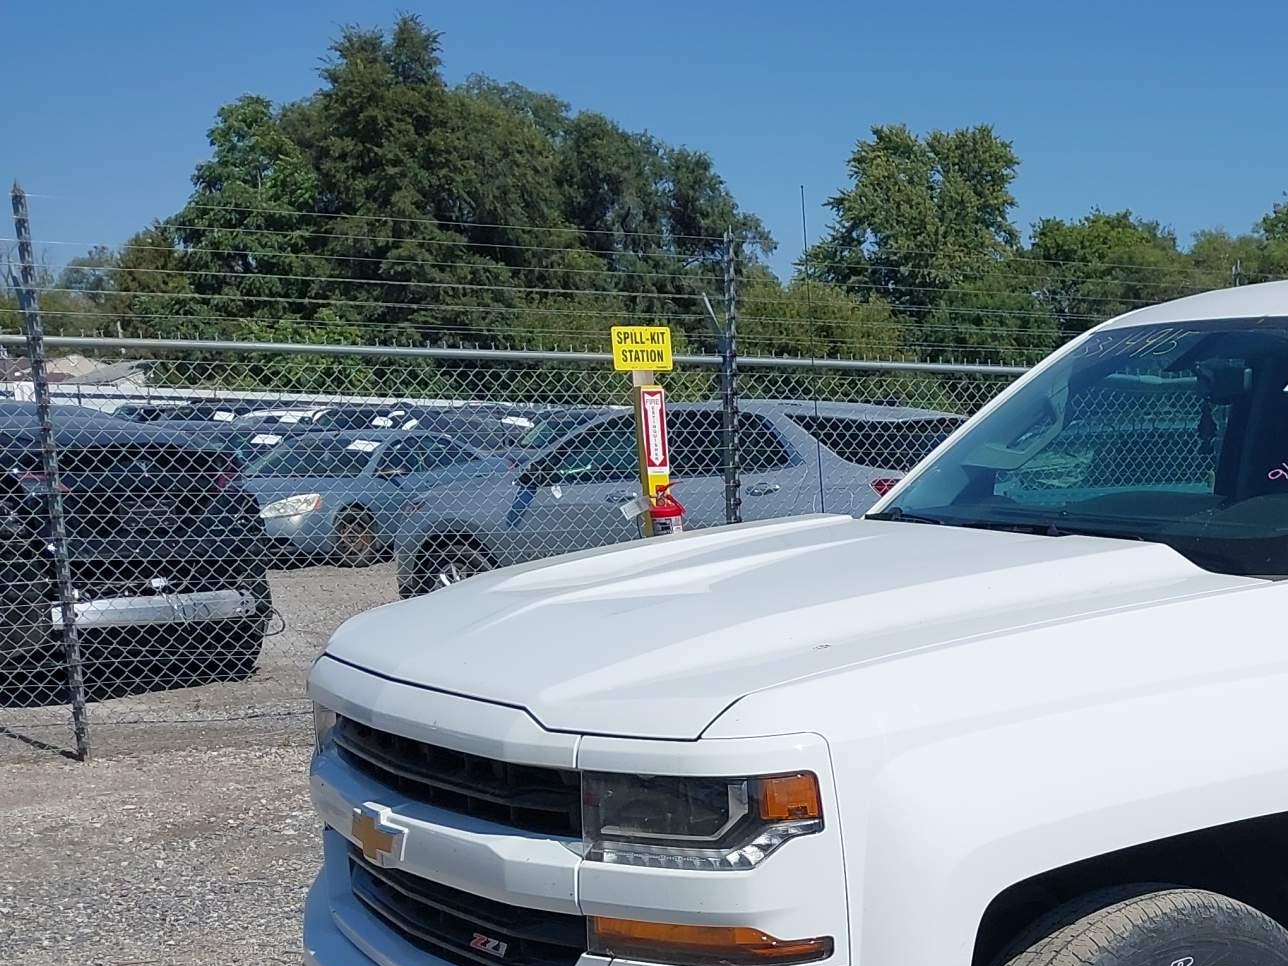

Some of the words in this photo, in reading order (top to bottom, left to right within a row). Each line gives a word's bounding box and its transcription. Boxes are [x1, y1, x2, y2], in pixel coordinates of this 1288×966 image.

[616, 331, 666, 345] SPILL-KIT
[621, 349, 664, 363] STATION
[470, 932, 508, 958] Z71
